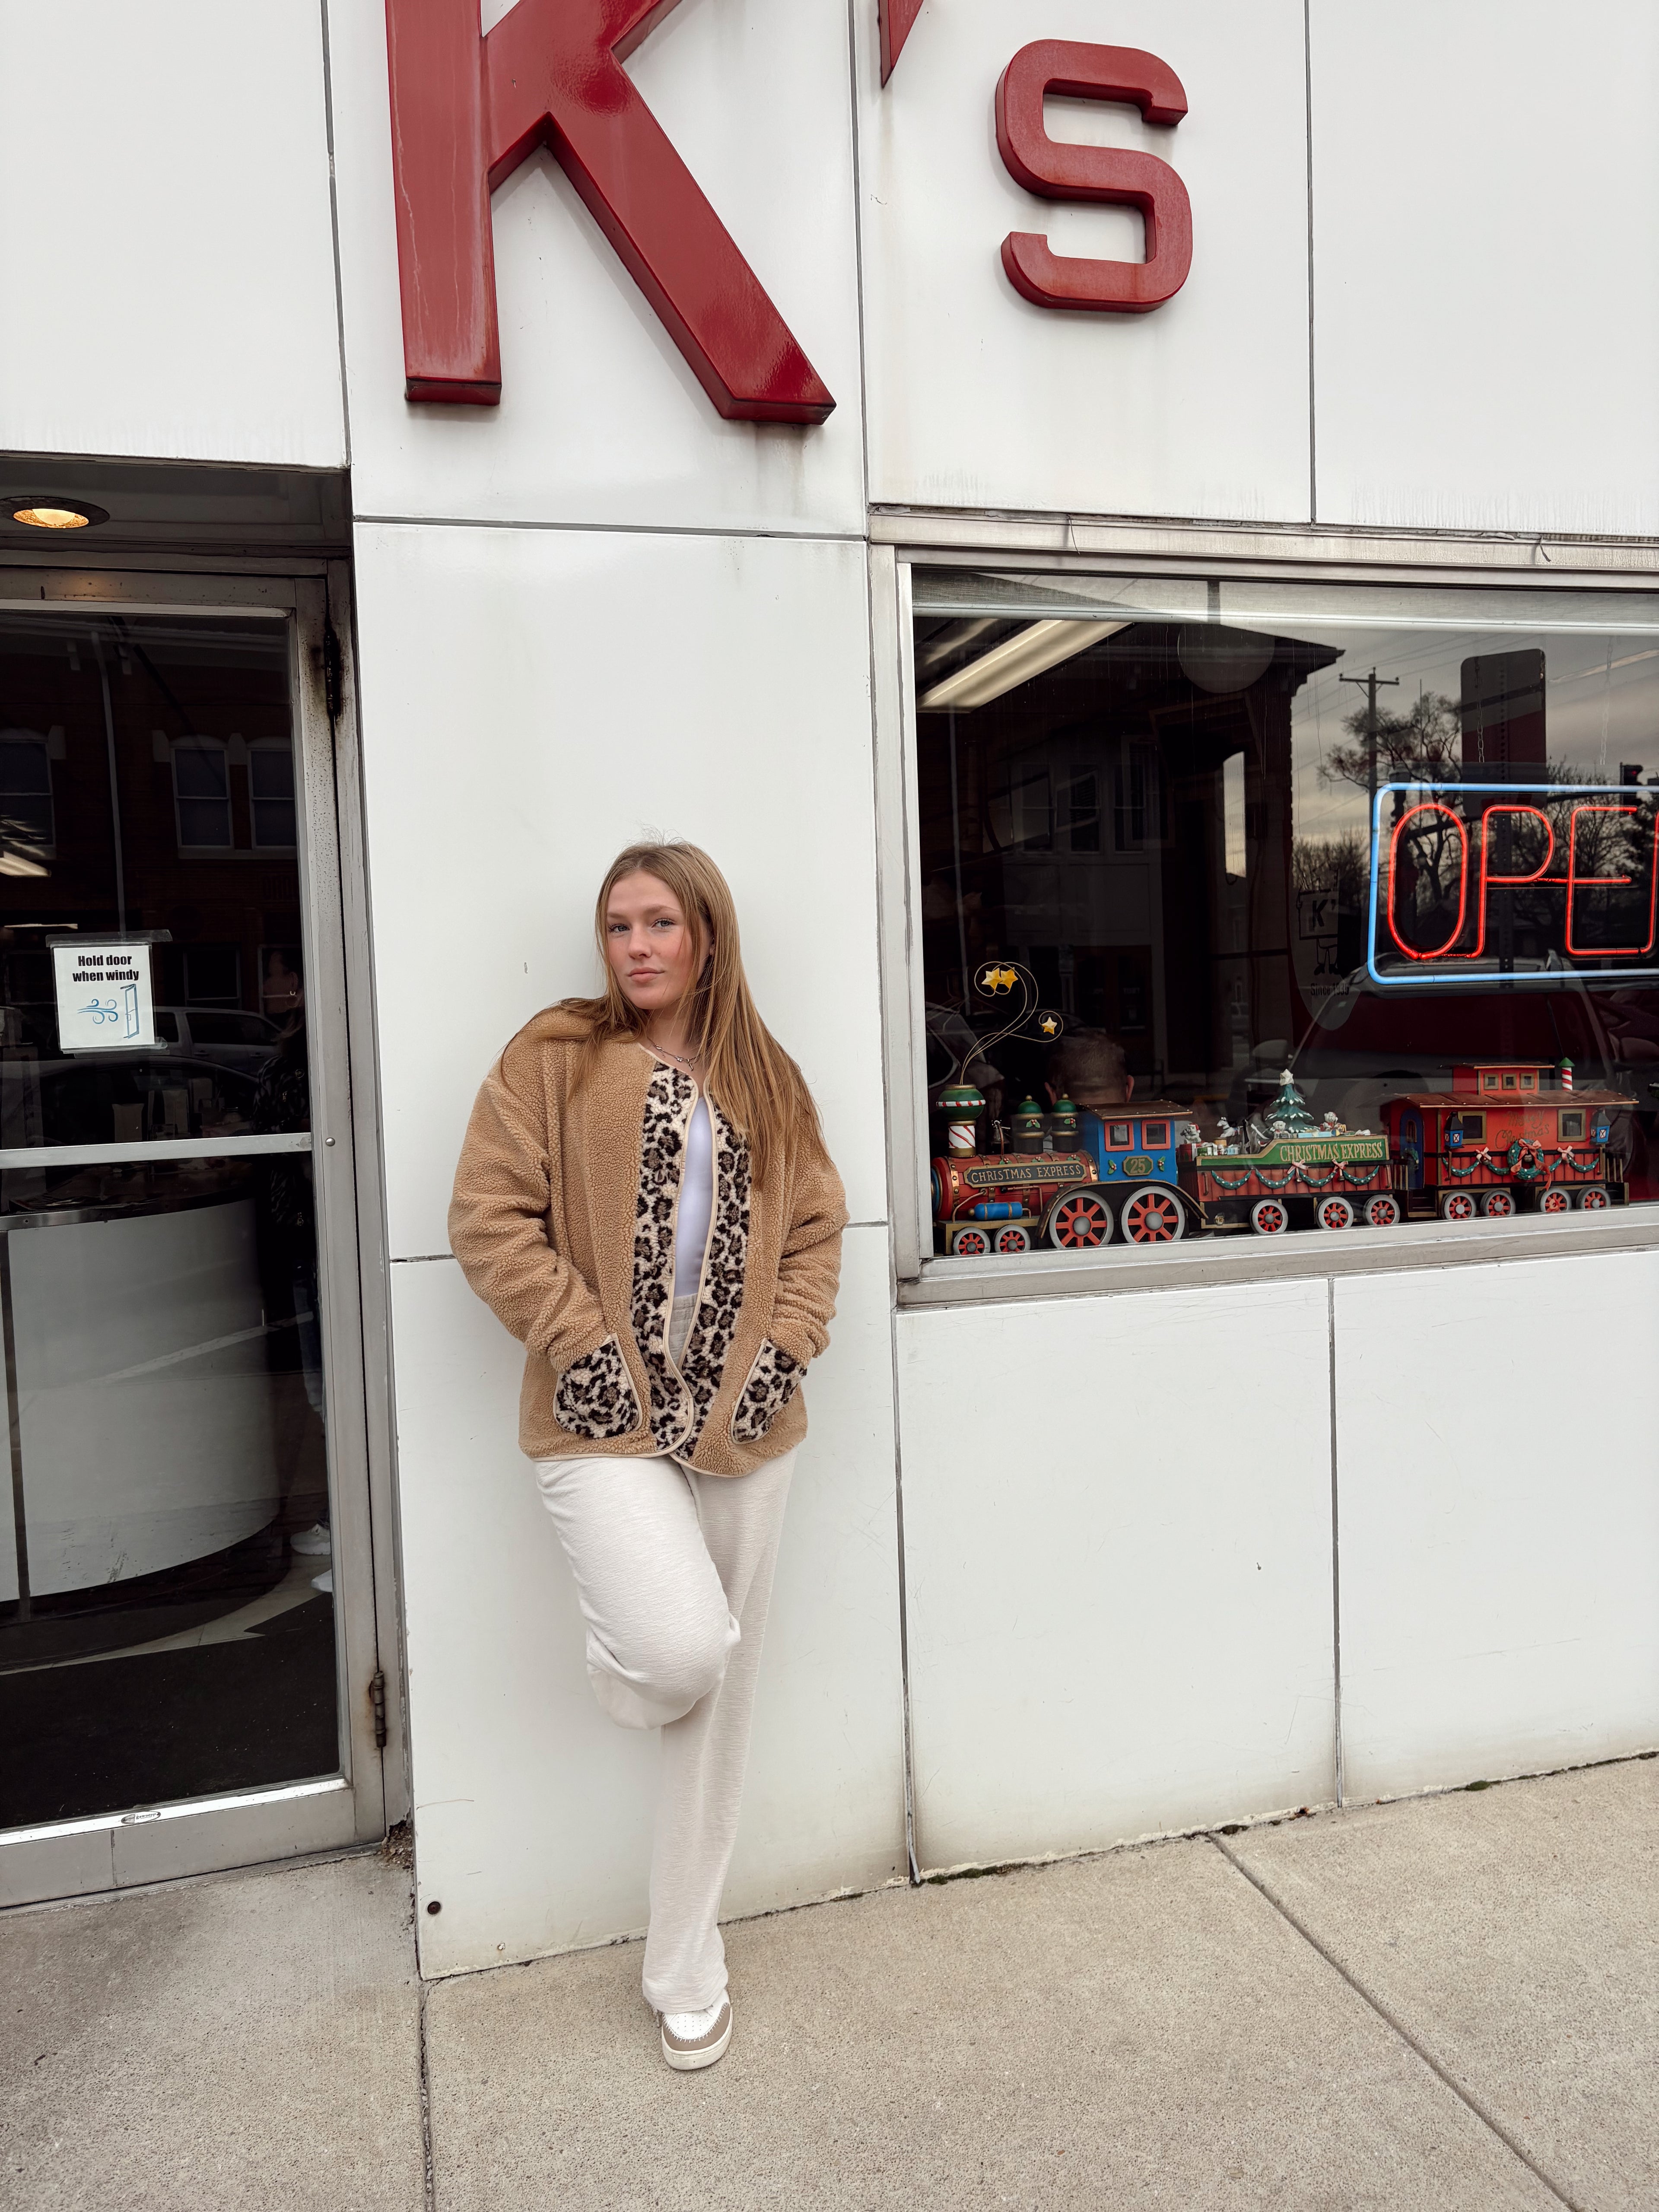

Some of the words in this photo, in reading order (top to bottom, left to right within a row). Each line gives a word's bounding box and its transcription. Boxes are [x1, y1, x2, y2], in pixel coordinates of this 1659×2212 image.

[1388, 803, 1659, 959] OPE
[78, 955, 104, 966] Hold
[106, 955, 132, 966] door
[73, 971, 104, 982] when
[106, 969, 139, 981] windy
[1280, 1143, 1339, 1162] CHRISTMAS
[1340, 1141, 1383, 1158] EXPRESS
[1130, 1158, 1145, 1173] 25
[971, 1168, 1031, 1183] CHRISTMAS
[1036, 1165, 1081, 1177] EXPRESS
